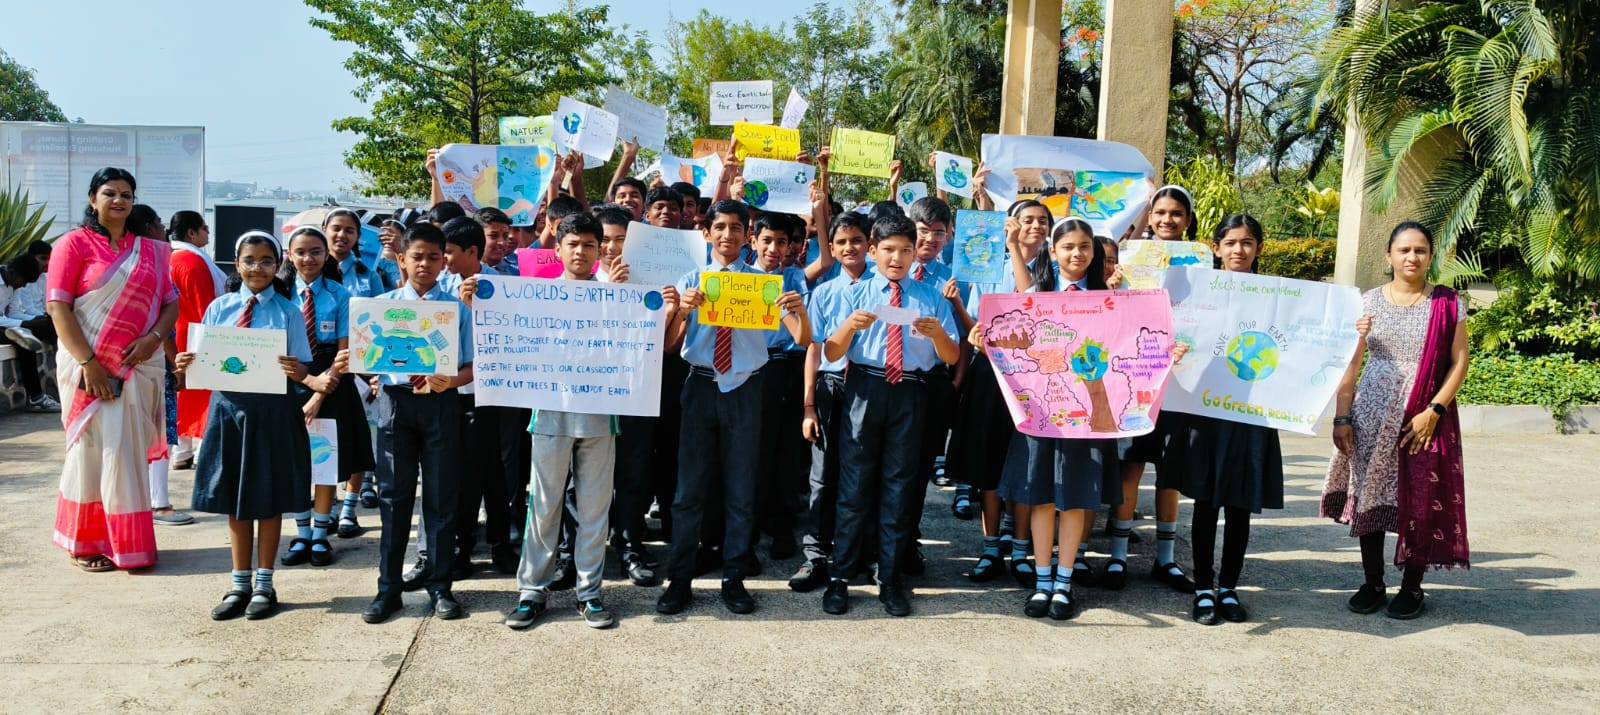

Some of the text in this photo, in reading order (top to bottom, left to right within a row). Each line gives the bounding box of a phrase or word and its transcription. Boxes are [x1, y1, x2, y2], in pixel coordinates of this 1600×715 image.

[718, 102, 730, 110] for
[510, 126, 544, 136] NATURE
[503, 281, 643, 303] WORLDS EARTH DAY
[722, 275, 760, 292] Planet
[475, 310, 656, 329] LESS POLLUTION IS THE BEST SOLUTION
[723, 307, 757, 325] Profit
[476, 332, 500, 345] LIFE
[504, 335, 513, 344] IS
[587, 339, 613, 348] EARTH
[646, 343, 655, 352] IT
[1213, 333, 1230, 356] SAVE
[1239, 320, 1256, 329] OUR
[1267, 325, 1288, 352] EARTH
[478, 346, 540, 356] FROM POLLUTION
[477, 363, 497, 371] SAVE
[515, 363, 538, 372] EARTH
[576, 365, 618, 374] CLASSROOM
[507, 380, 523, 388] CUT
[608, 386, 631, 396] EARTH
